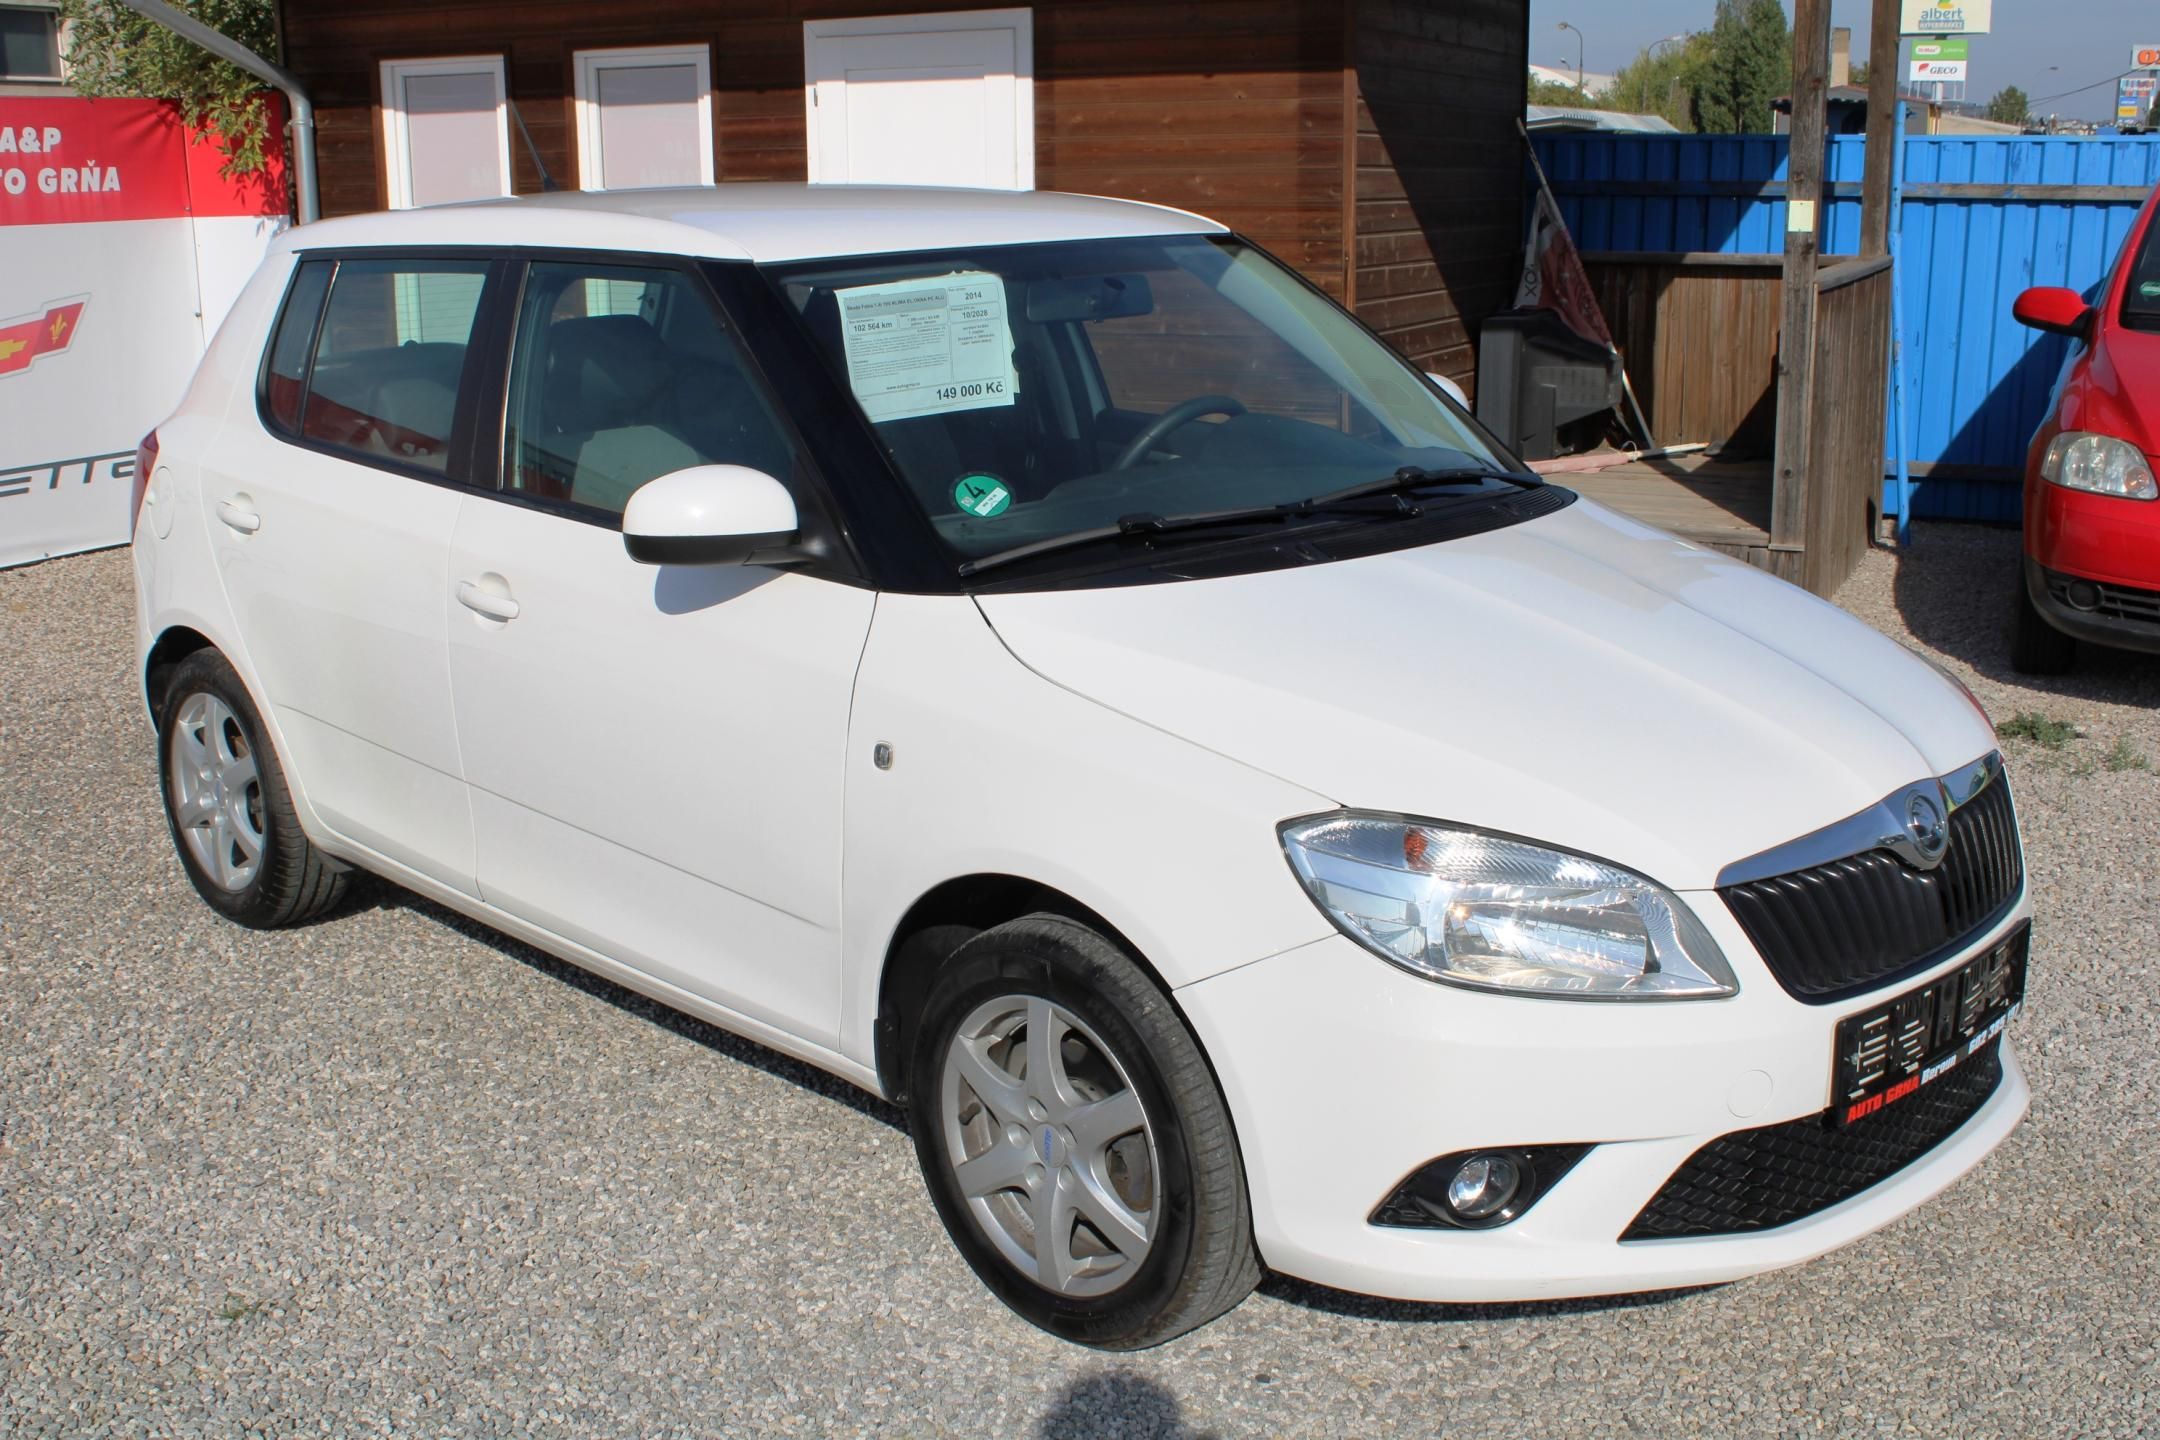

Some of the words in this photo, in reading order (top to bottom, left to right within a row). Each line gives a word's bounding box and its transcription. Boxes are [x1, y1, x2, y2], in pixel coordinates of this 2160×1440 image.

[1920, 8, 1963, 20] albert
[1930, 66, 1958, 75] GECO
[0, 126, 61, 153] A&P
[0, 167, 26, 195] O
[38, 159, 121, 194] GRŇA
[965, 291, 982, 300] 2014
[962, 309, 988, 319] 10/2028
[854, 324, 866, 332] 102
[881, 321, 893, 329] km
[936, 386, 957, 401] 149
[960, 383, 982, 397] 000
[986, 381, 1004, 394] Kč
[964, 482, 986, 499] 4
[1846, 1093, 1883, 1125] AUTO
